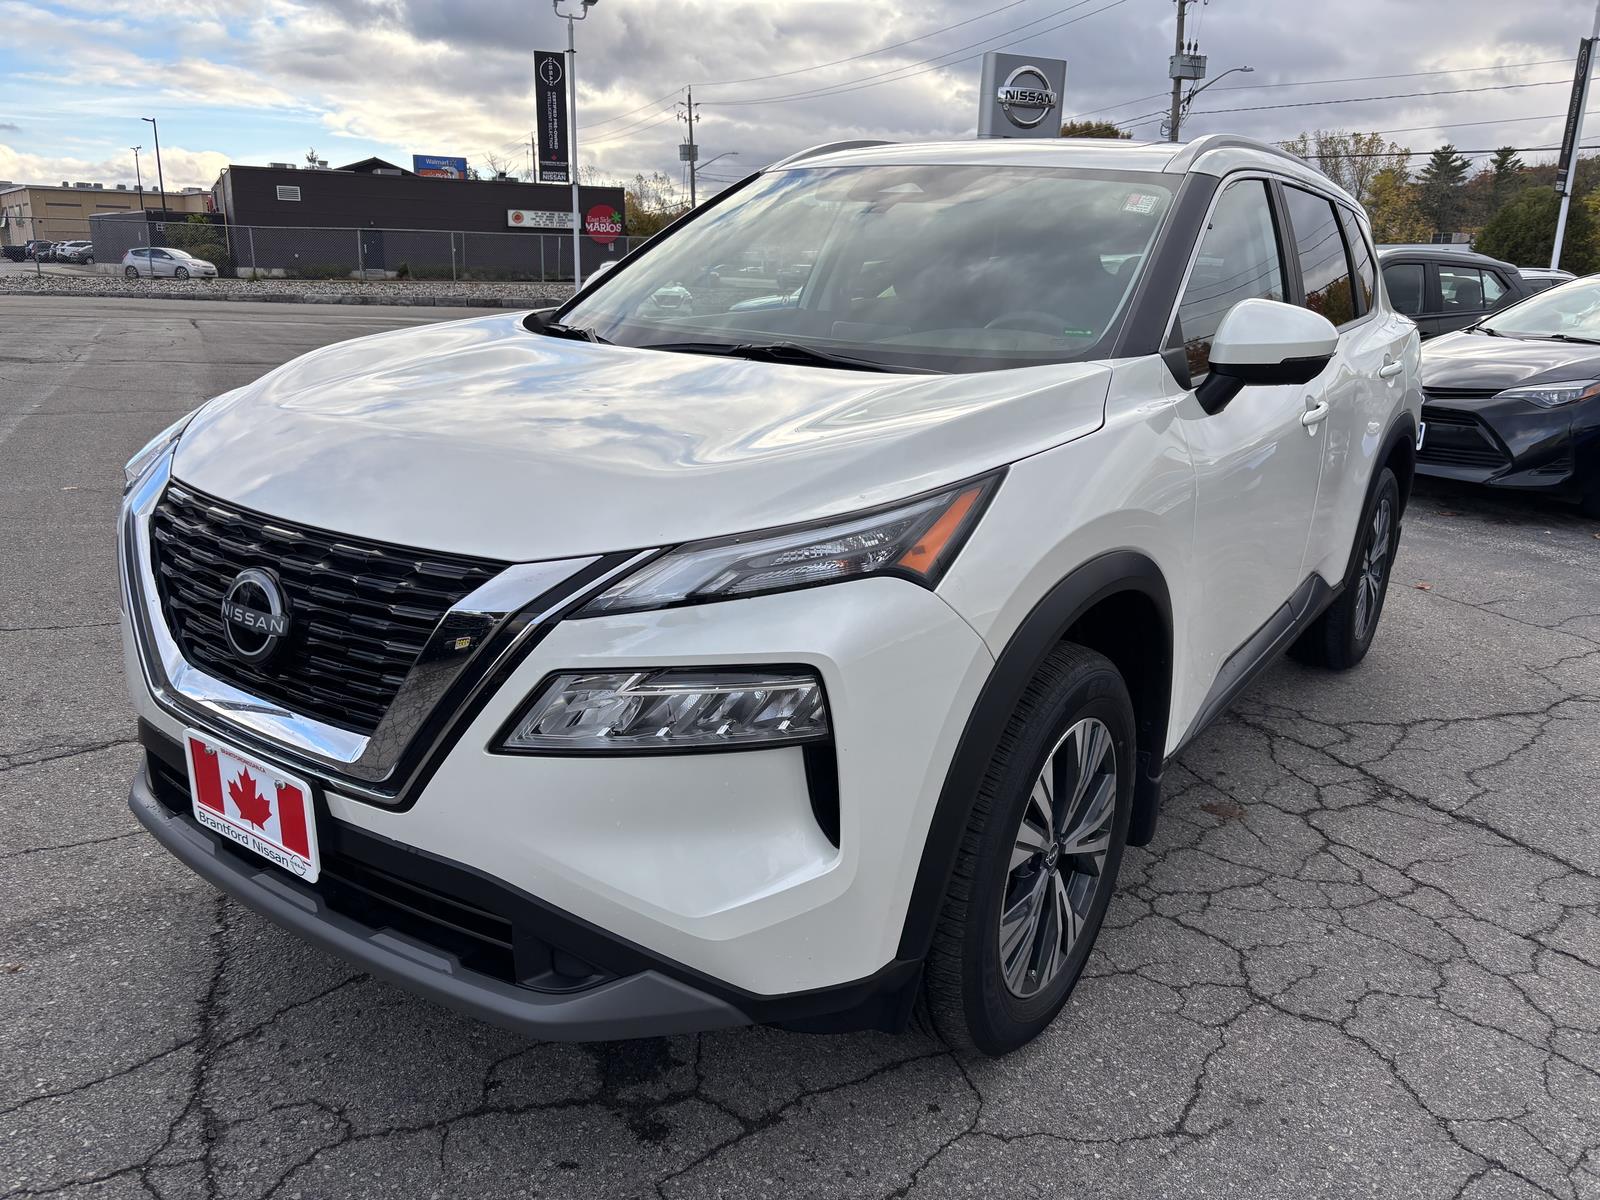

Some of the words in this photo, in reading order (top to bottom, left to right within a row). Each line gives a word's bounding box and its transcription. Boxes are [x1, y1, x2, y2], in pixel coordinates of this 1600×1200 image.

[1005, 90, 1053, 104] NISSAN
[425, 158, 449, 166] Walmart
[585, 222, 622, 233] MARIOS
[222, 599, 284, 633] NISSAN
[198, 810, 250, 846] Brantford
[252, 838, 290, 868] Nissan
